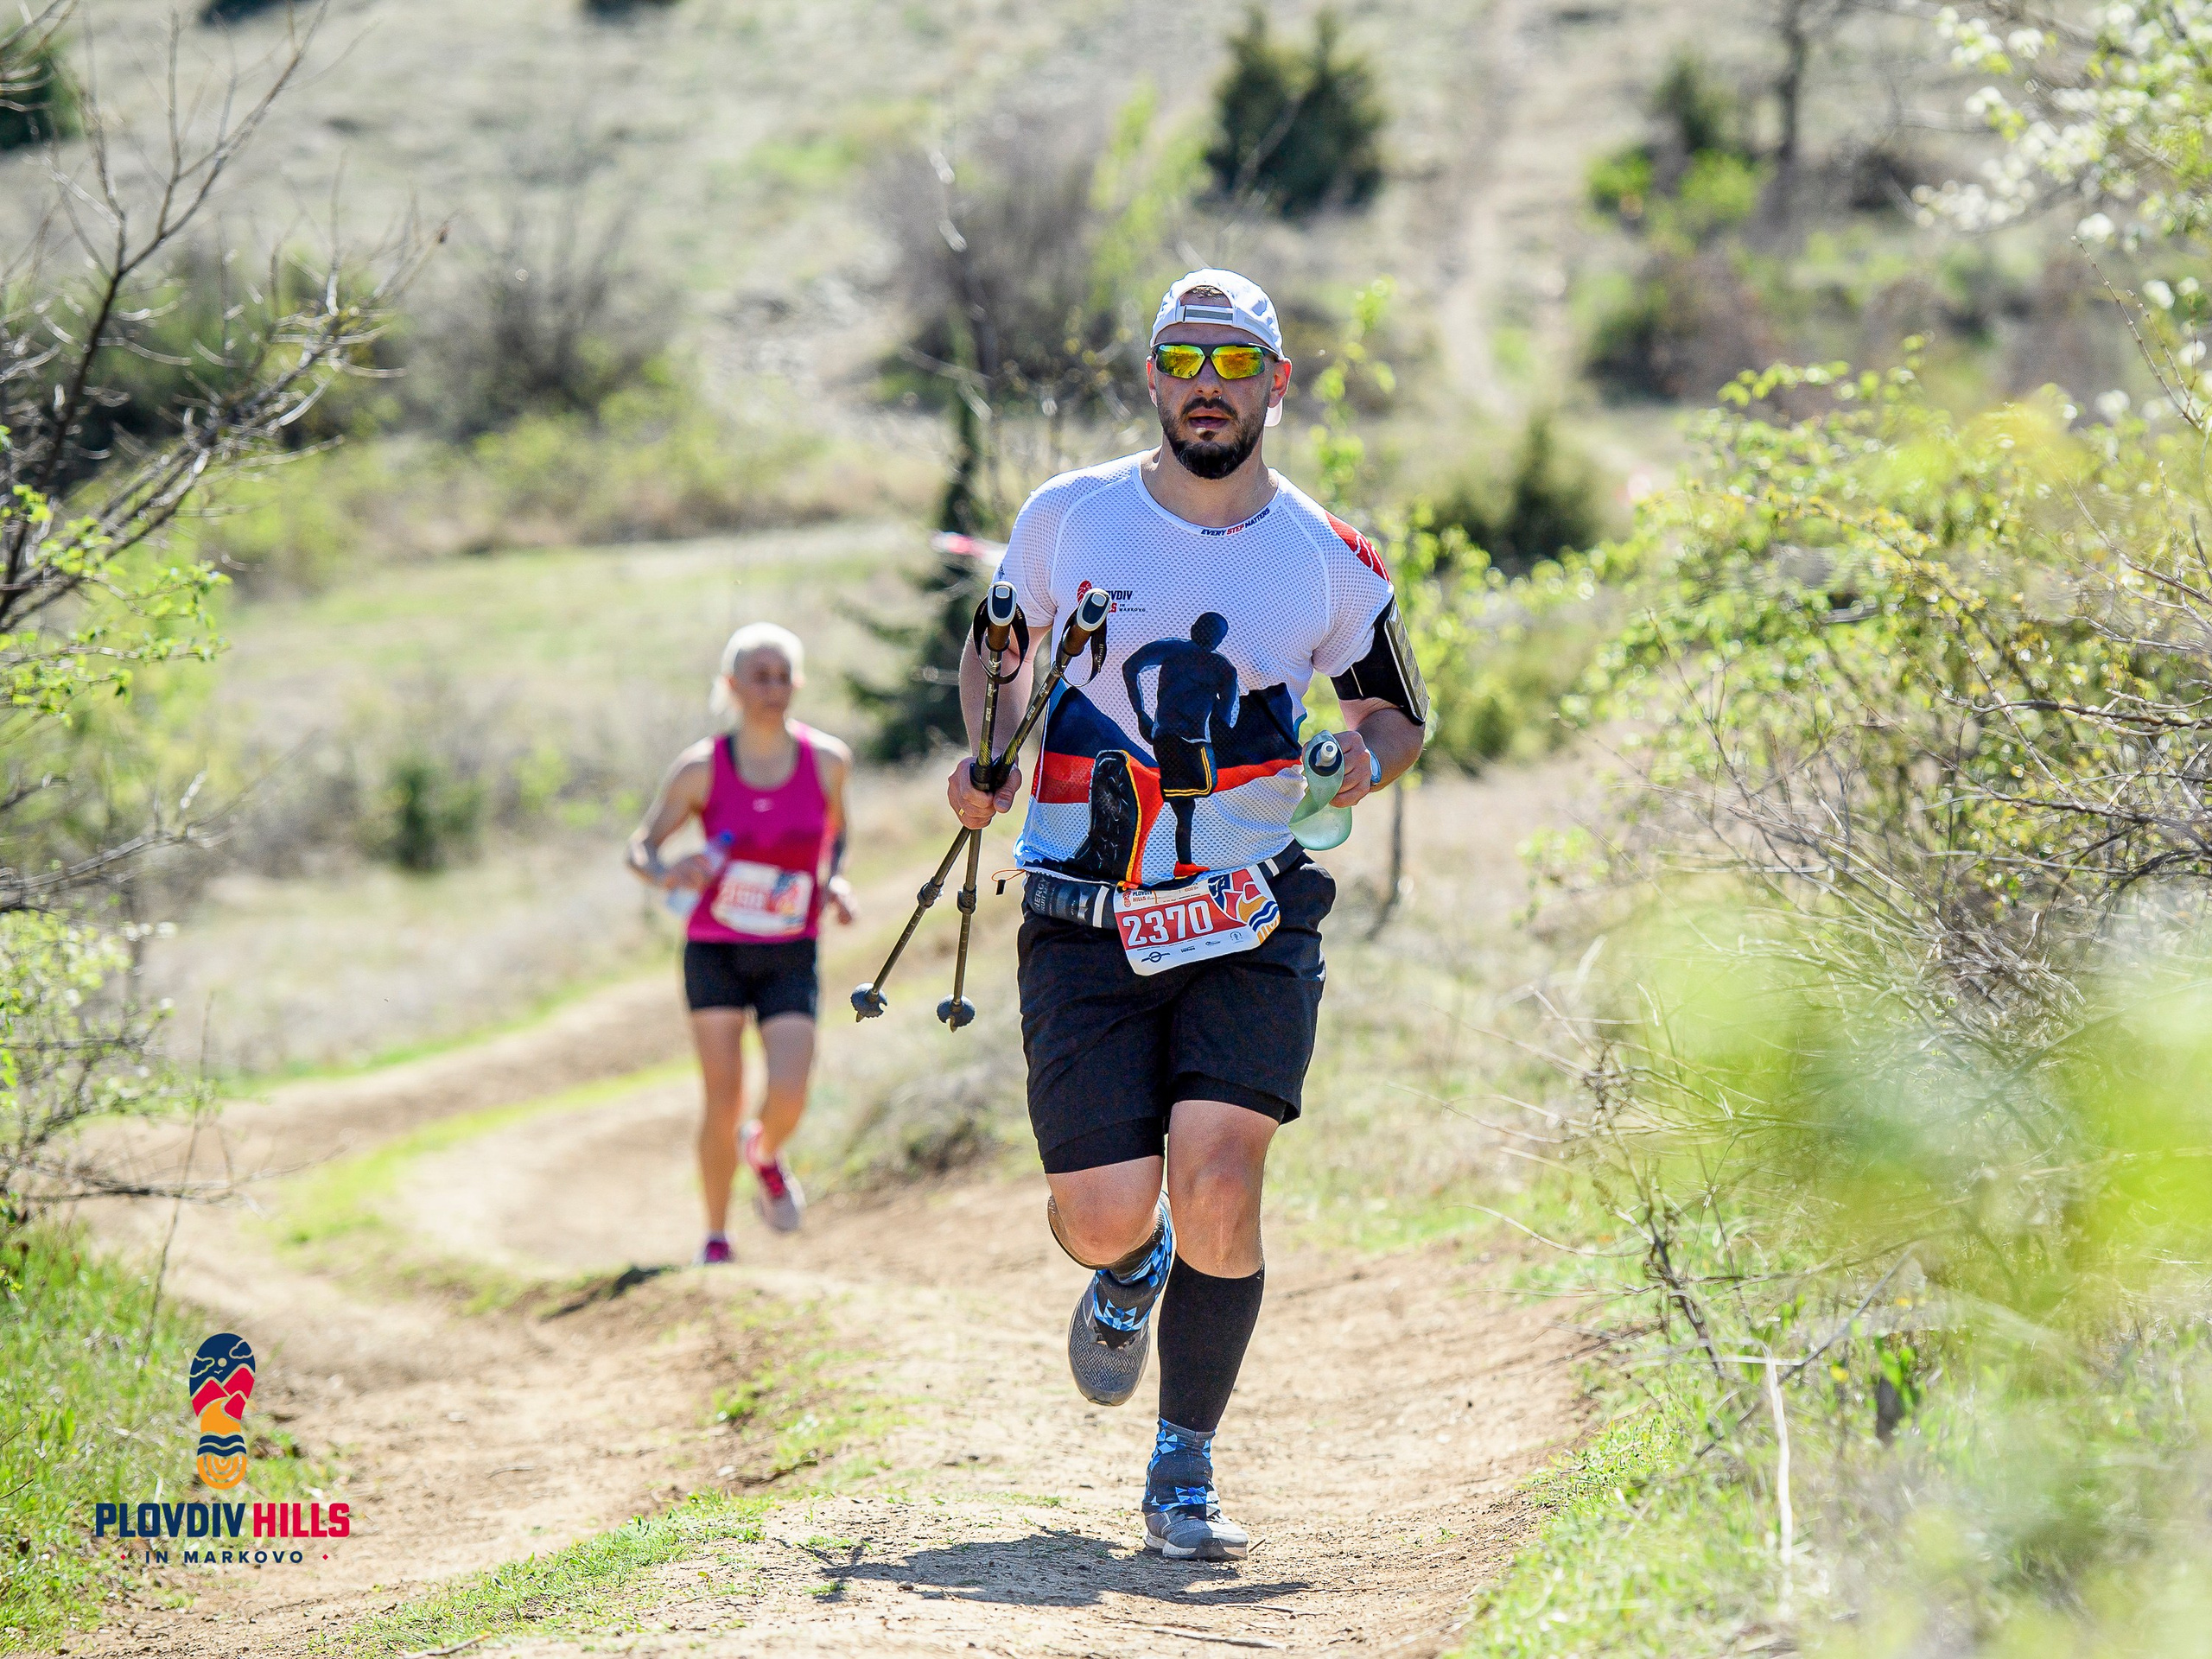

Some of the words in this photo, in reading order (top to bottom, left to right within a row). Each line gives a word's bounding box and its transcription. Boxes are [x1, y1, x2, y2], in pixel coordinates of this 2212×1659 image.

[1227, 524, 1244, 535] STEP
[1244, 507, 1270, 528] MATTERS
[1106, 590, 1134, 601] VDIV
[1034, 877, 1046, 911] NERGY
[1123, 900, 1214, 946] 2370
